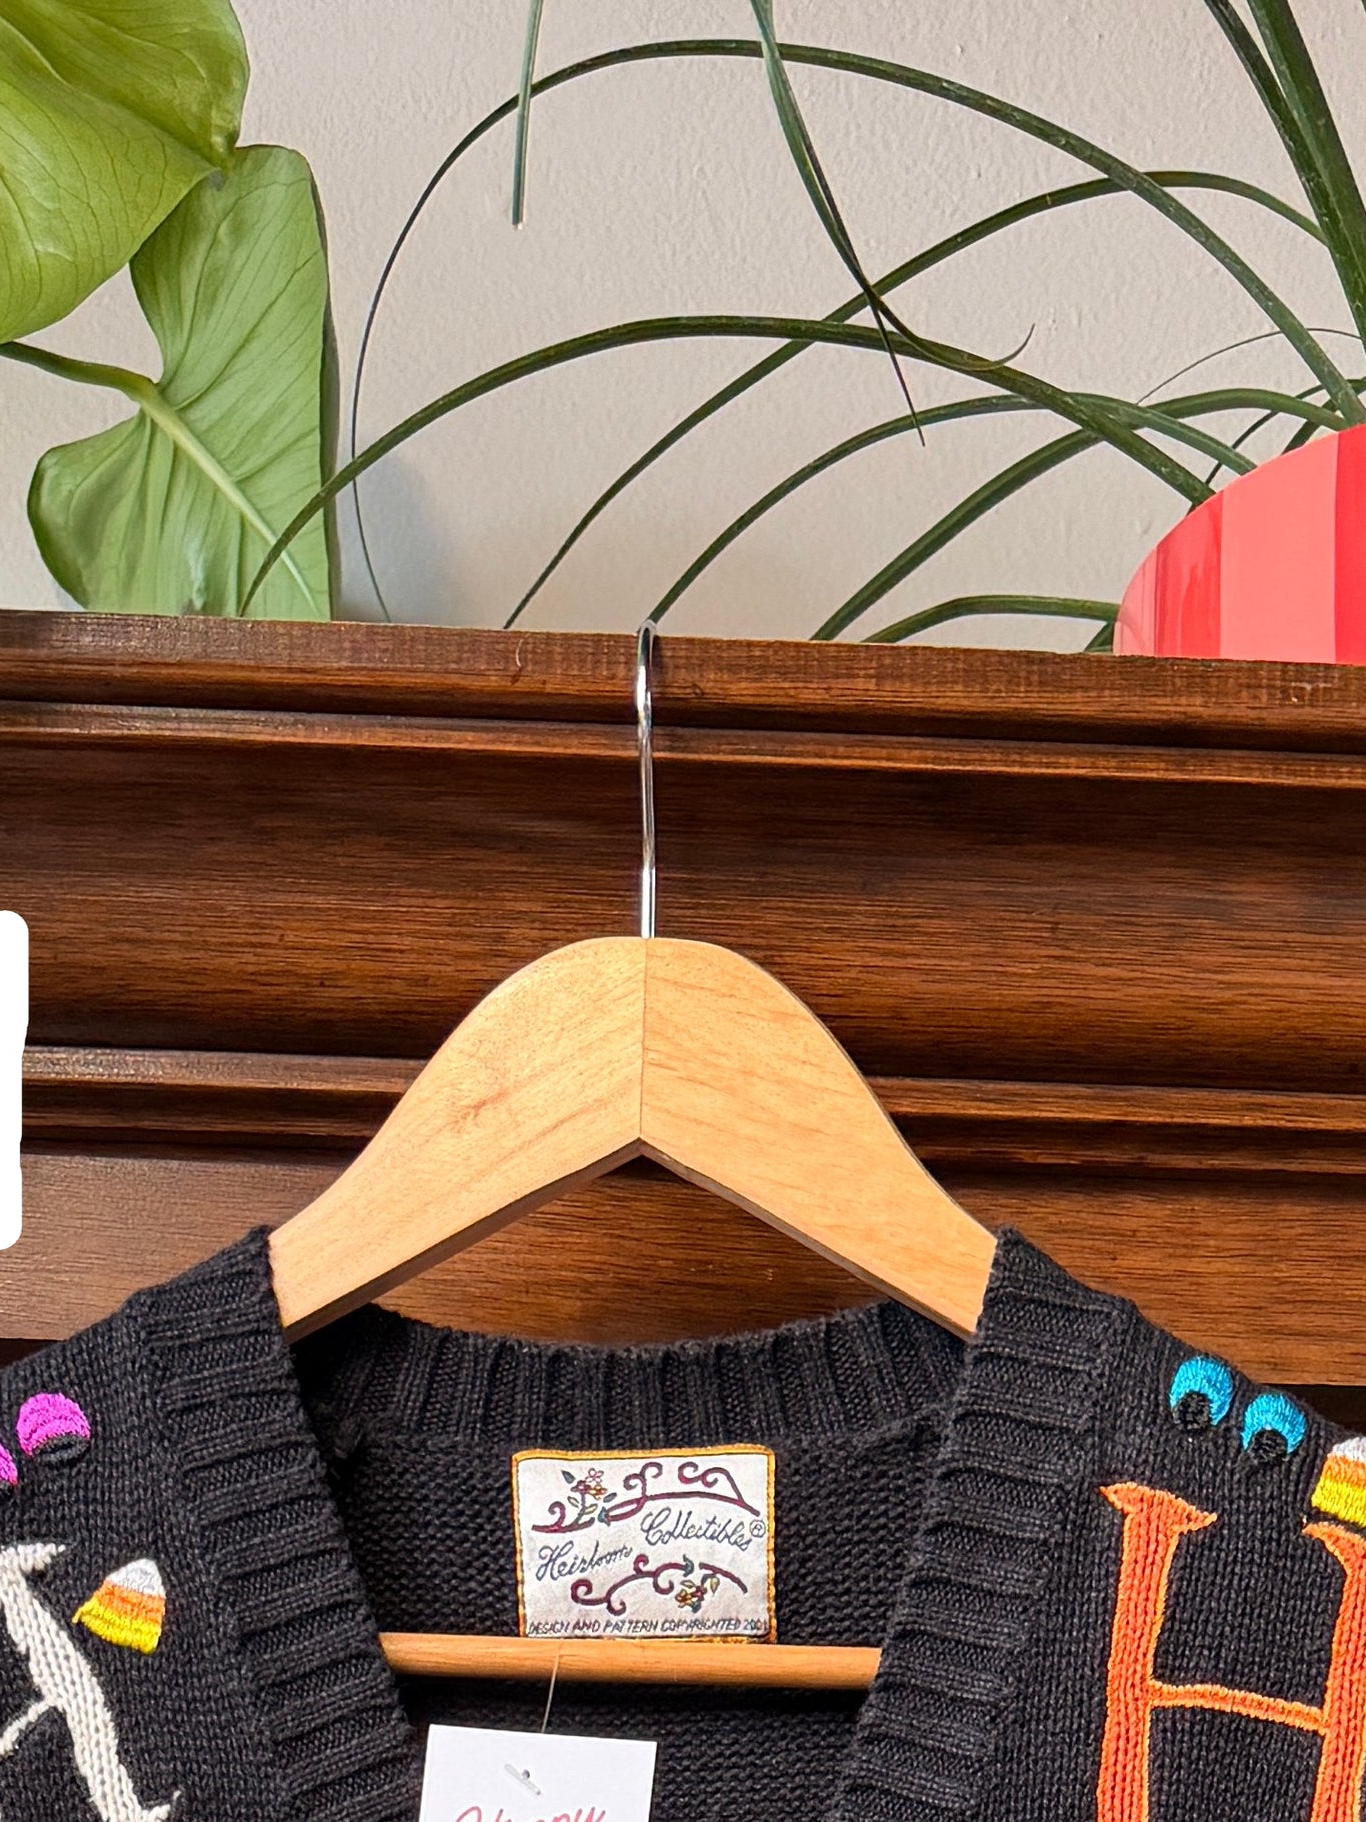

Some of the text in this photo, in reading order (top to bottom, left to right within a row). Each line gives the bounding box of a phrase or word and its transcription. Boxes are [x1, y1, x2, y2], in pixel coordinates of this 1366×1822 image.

[529, 1620, 569, 1635] DESIGN
[573, 1619, 600, 1633] AND
[603, 1618, 657, 1633] PATTERN
